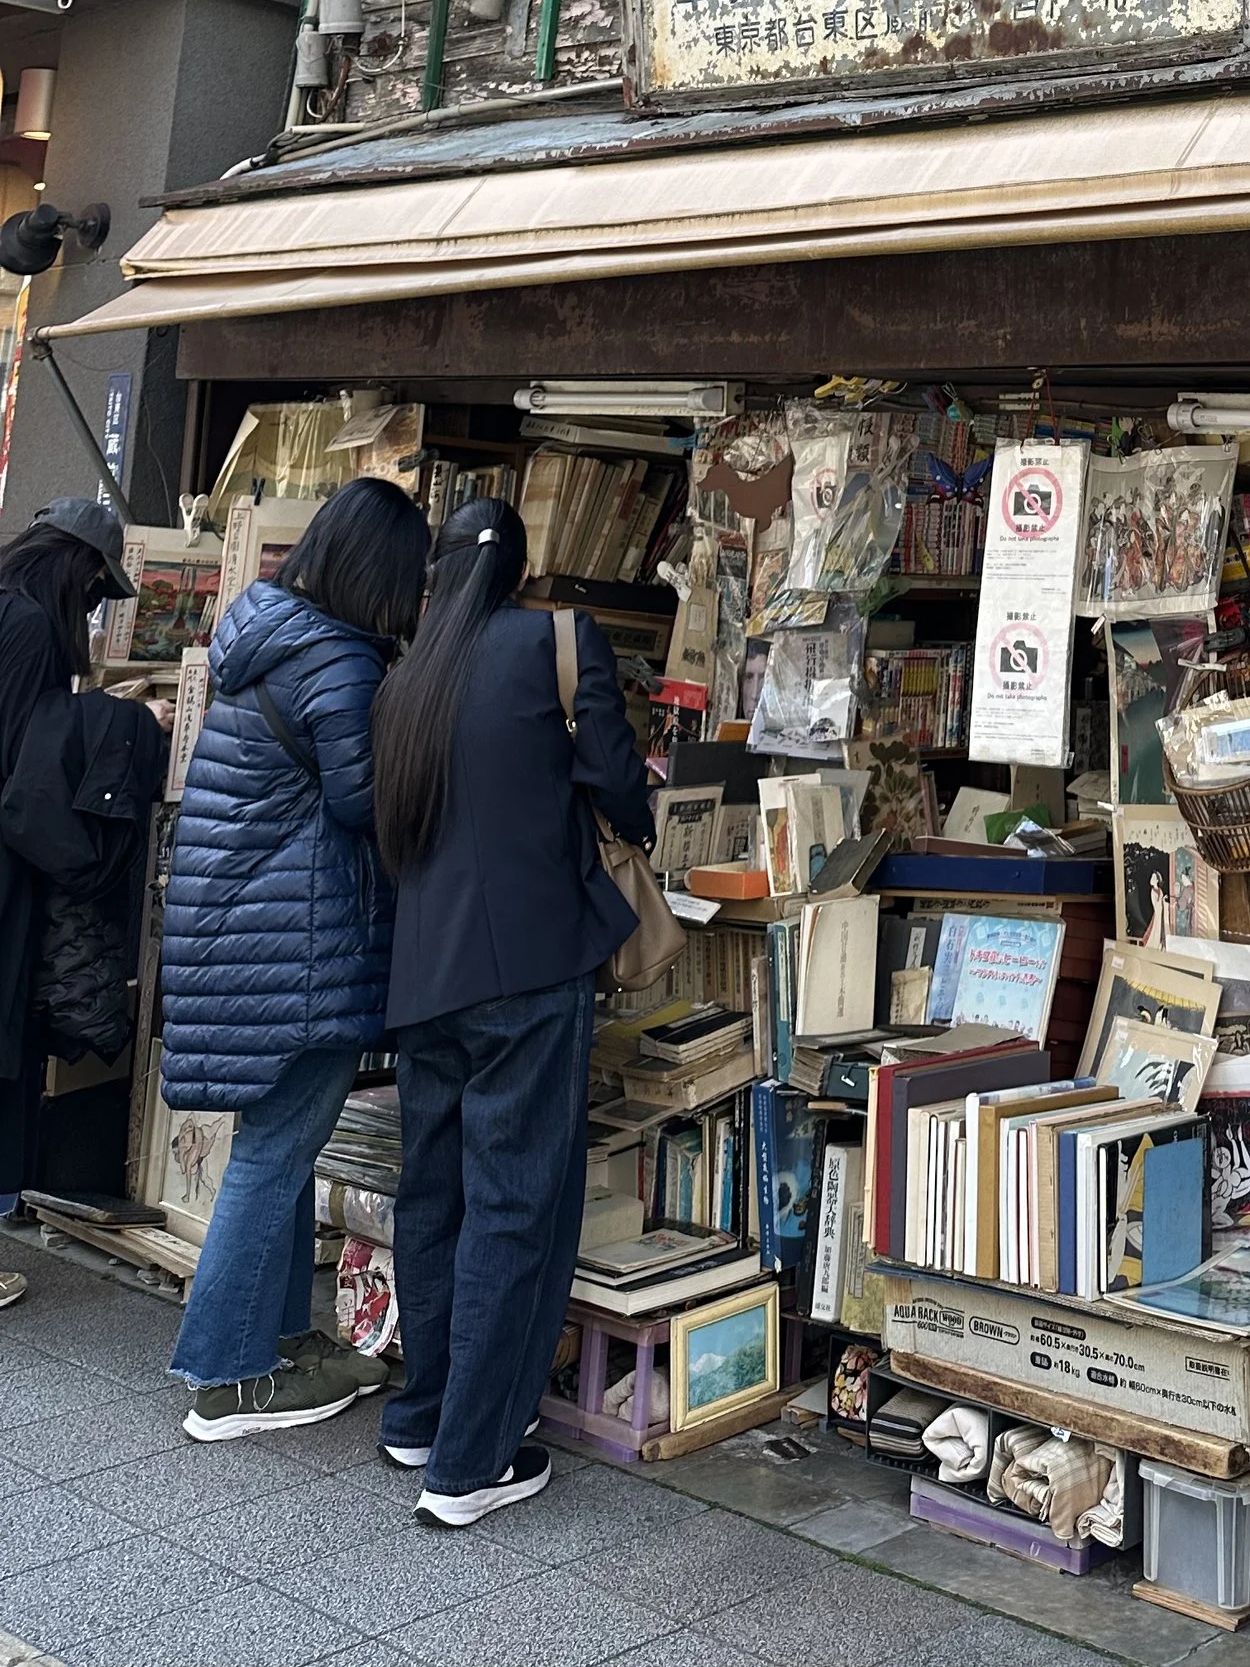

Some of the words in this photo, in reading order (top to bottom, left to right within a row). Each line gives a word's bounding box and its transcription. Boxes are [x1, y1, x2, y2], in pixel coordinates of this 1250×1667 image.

[823, 1157, 842, 1240] 原色陶器大辞典
[893, 1304, 916, 1320] AQUA
[917, 1307, 939, 1324] RACK
[973, 1321, 1004, 1339] BROWN
